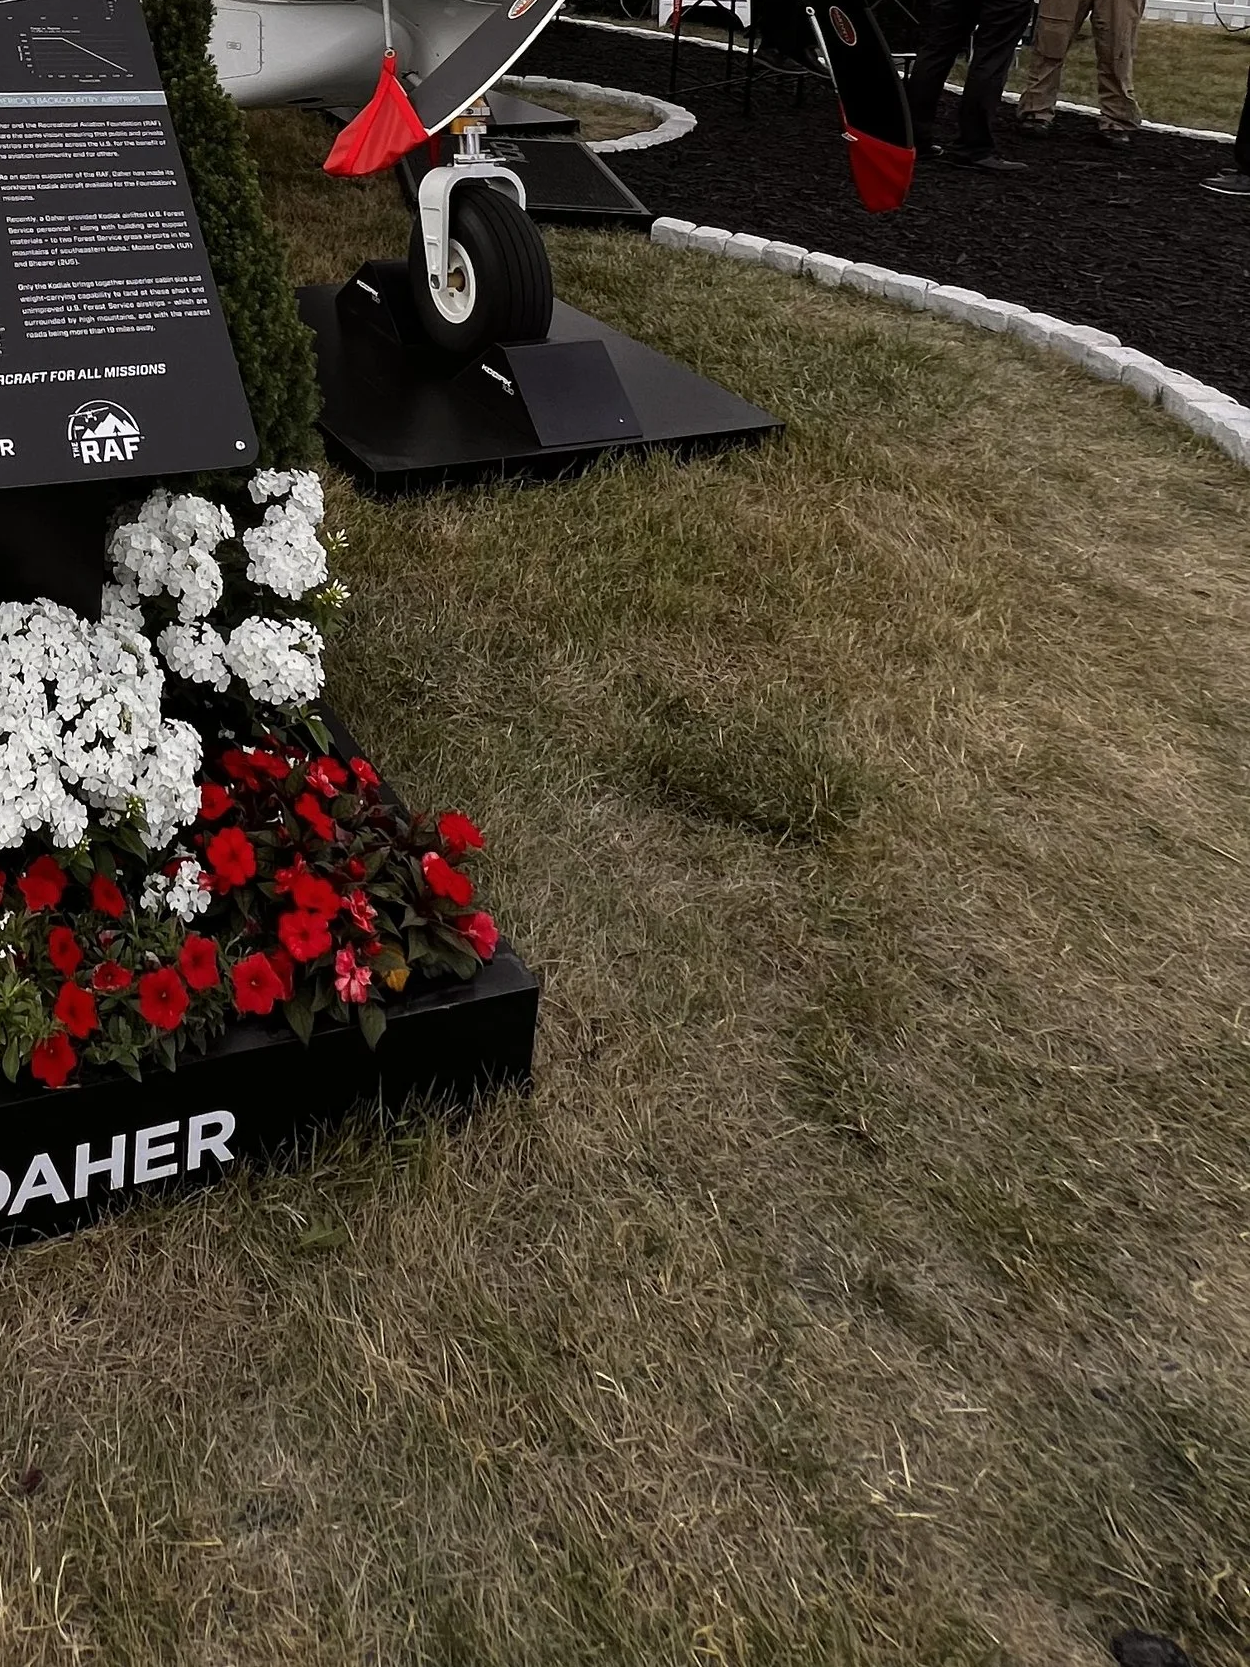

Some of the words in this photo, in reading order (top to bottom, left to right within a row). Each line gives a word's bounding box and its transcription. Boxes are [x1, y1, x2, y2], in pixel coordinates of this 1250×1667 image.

[100, 96, 141, 104] AIRSTRIPS
[49, 368, 76, 382] FOR
[76, 366, 102, 380] ALL
[103, 362, 166, 378] MISSIONS
[481, 364, 512, 388] KODIAK
[502, 383, 514, 396] 100
[72, 442, 80, 458] THE
[81, 437, 140, 464] RAF
